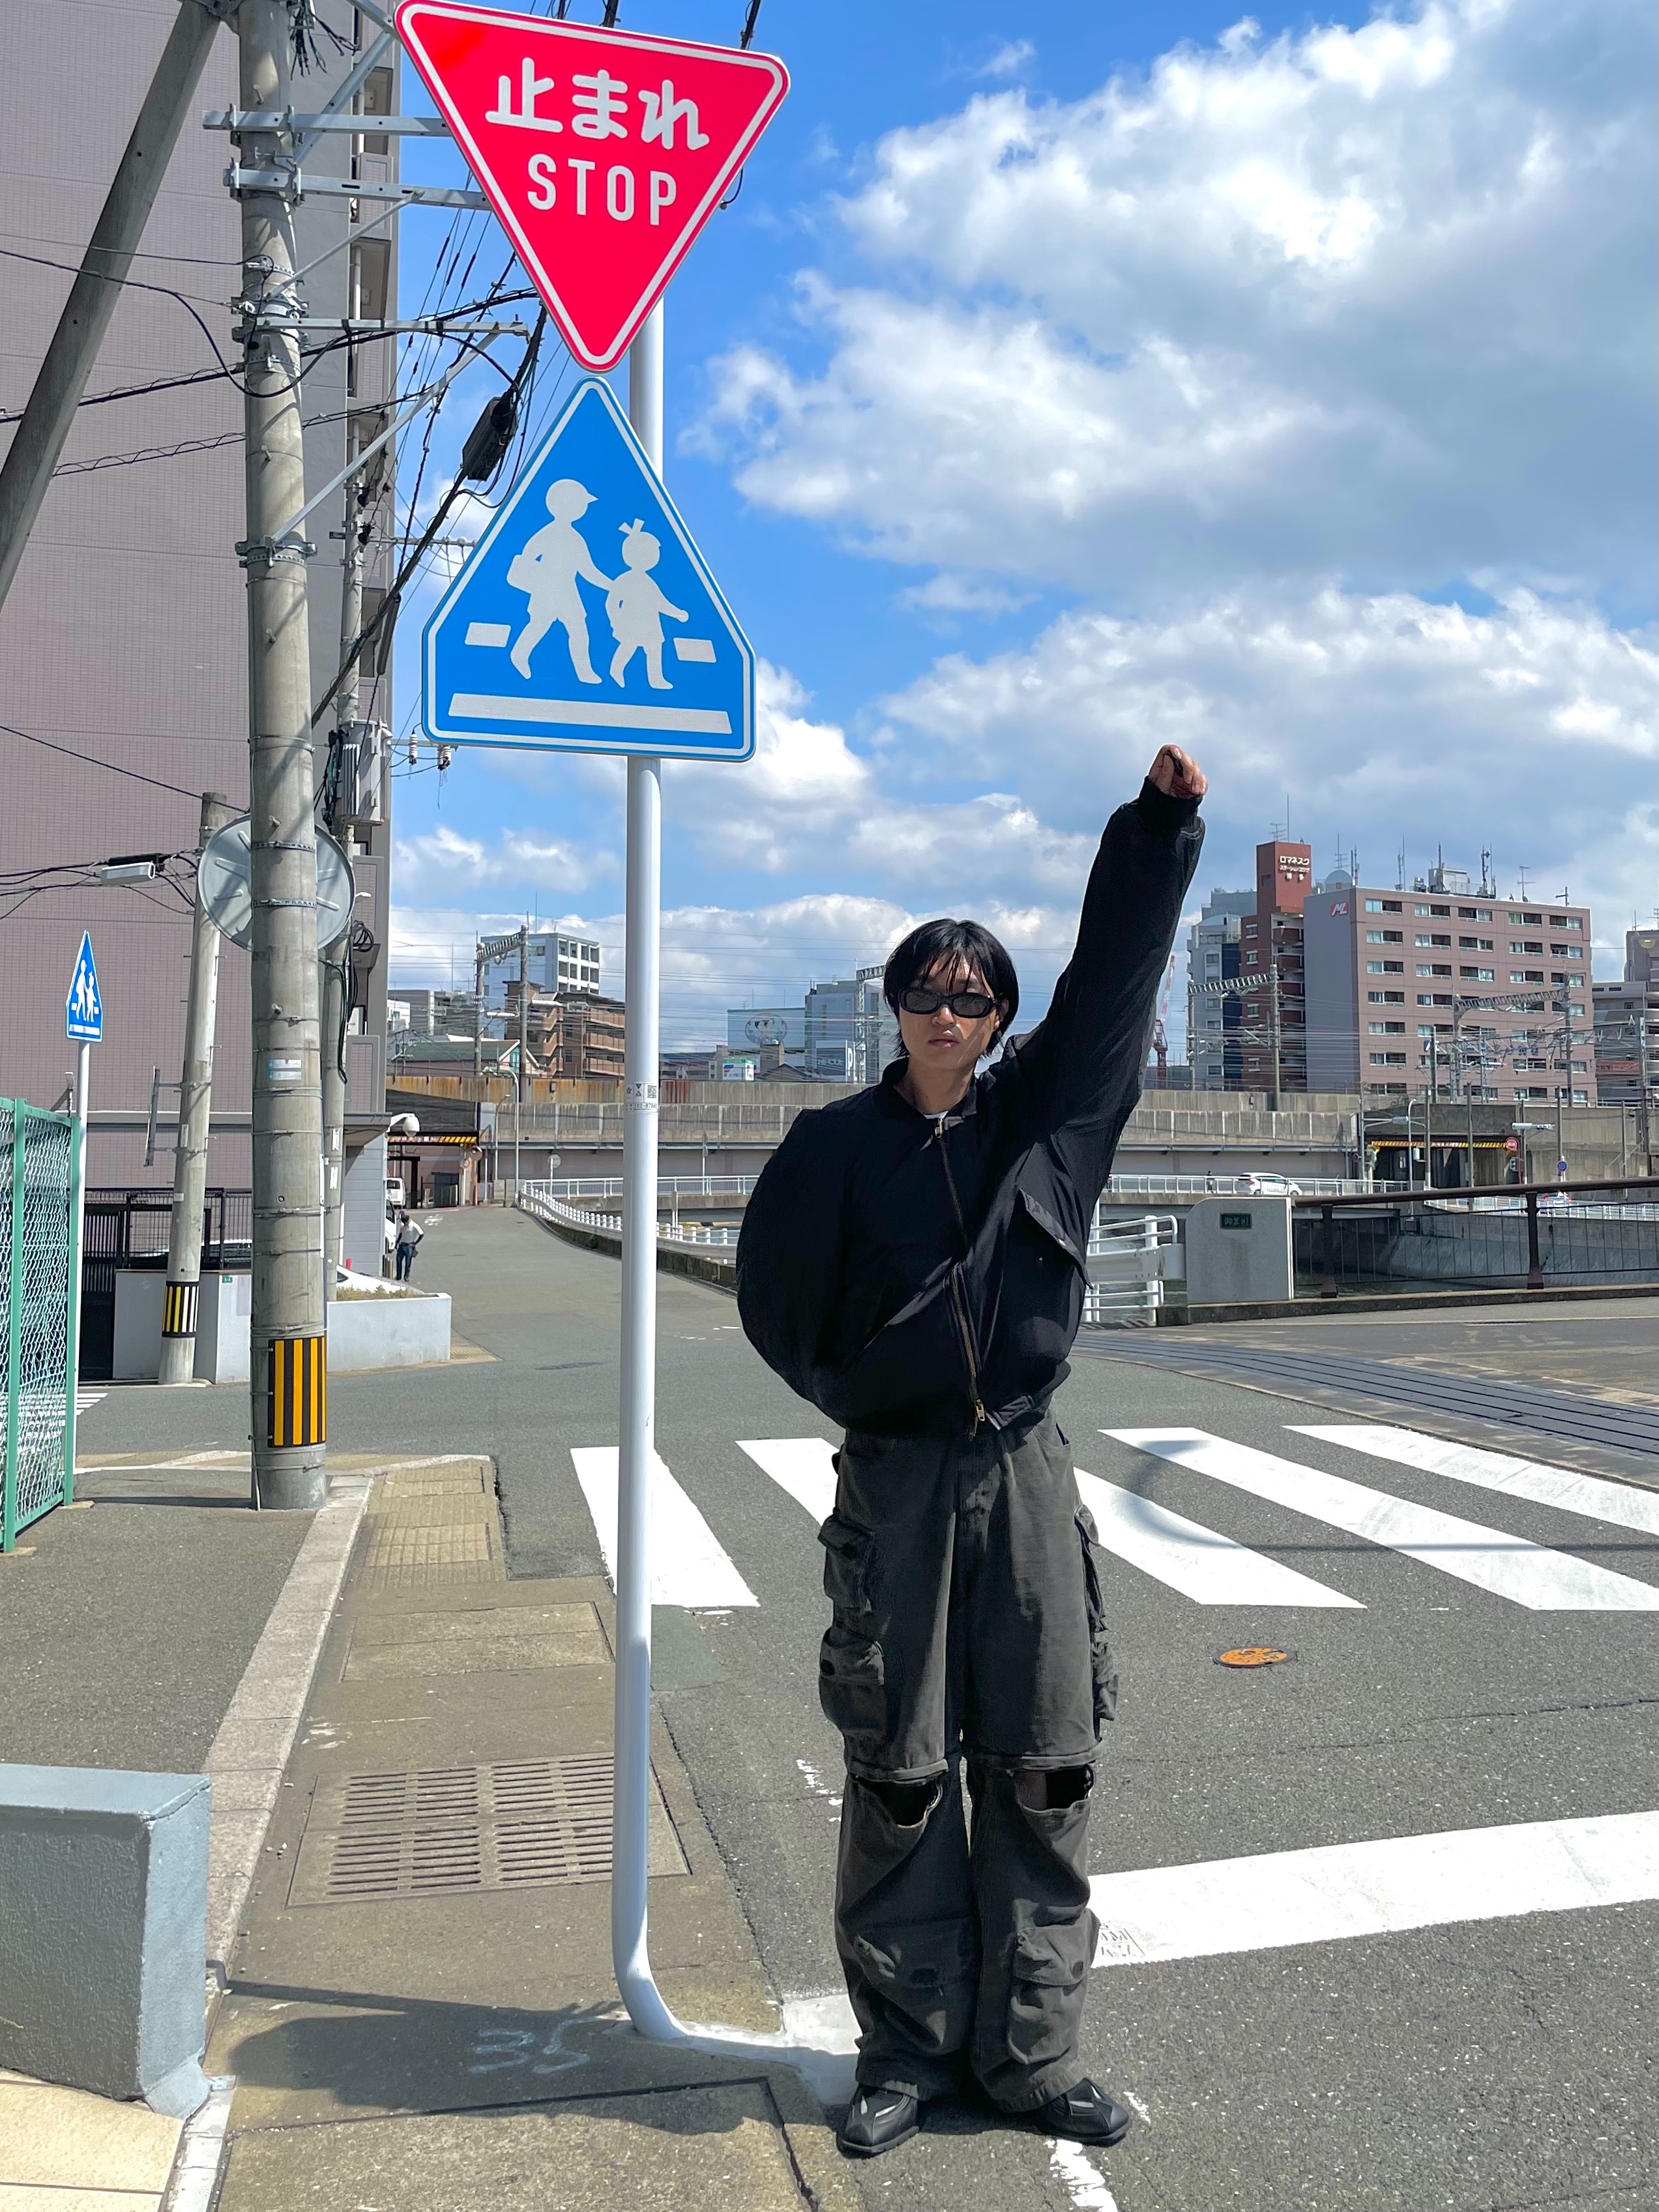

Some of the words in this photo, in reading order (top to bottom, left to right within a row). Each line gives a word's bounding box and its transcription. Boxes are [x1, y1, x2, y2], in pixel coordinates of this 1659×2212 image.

[485, 57, 709, 150] 止まれ
[527, 153, 677, 226] STOP
[1280, 855, 1310, 866] ロマネスク
[847, 1047, 853, 1077] P
